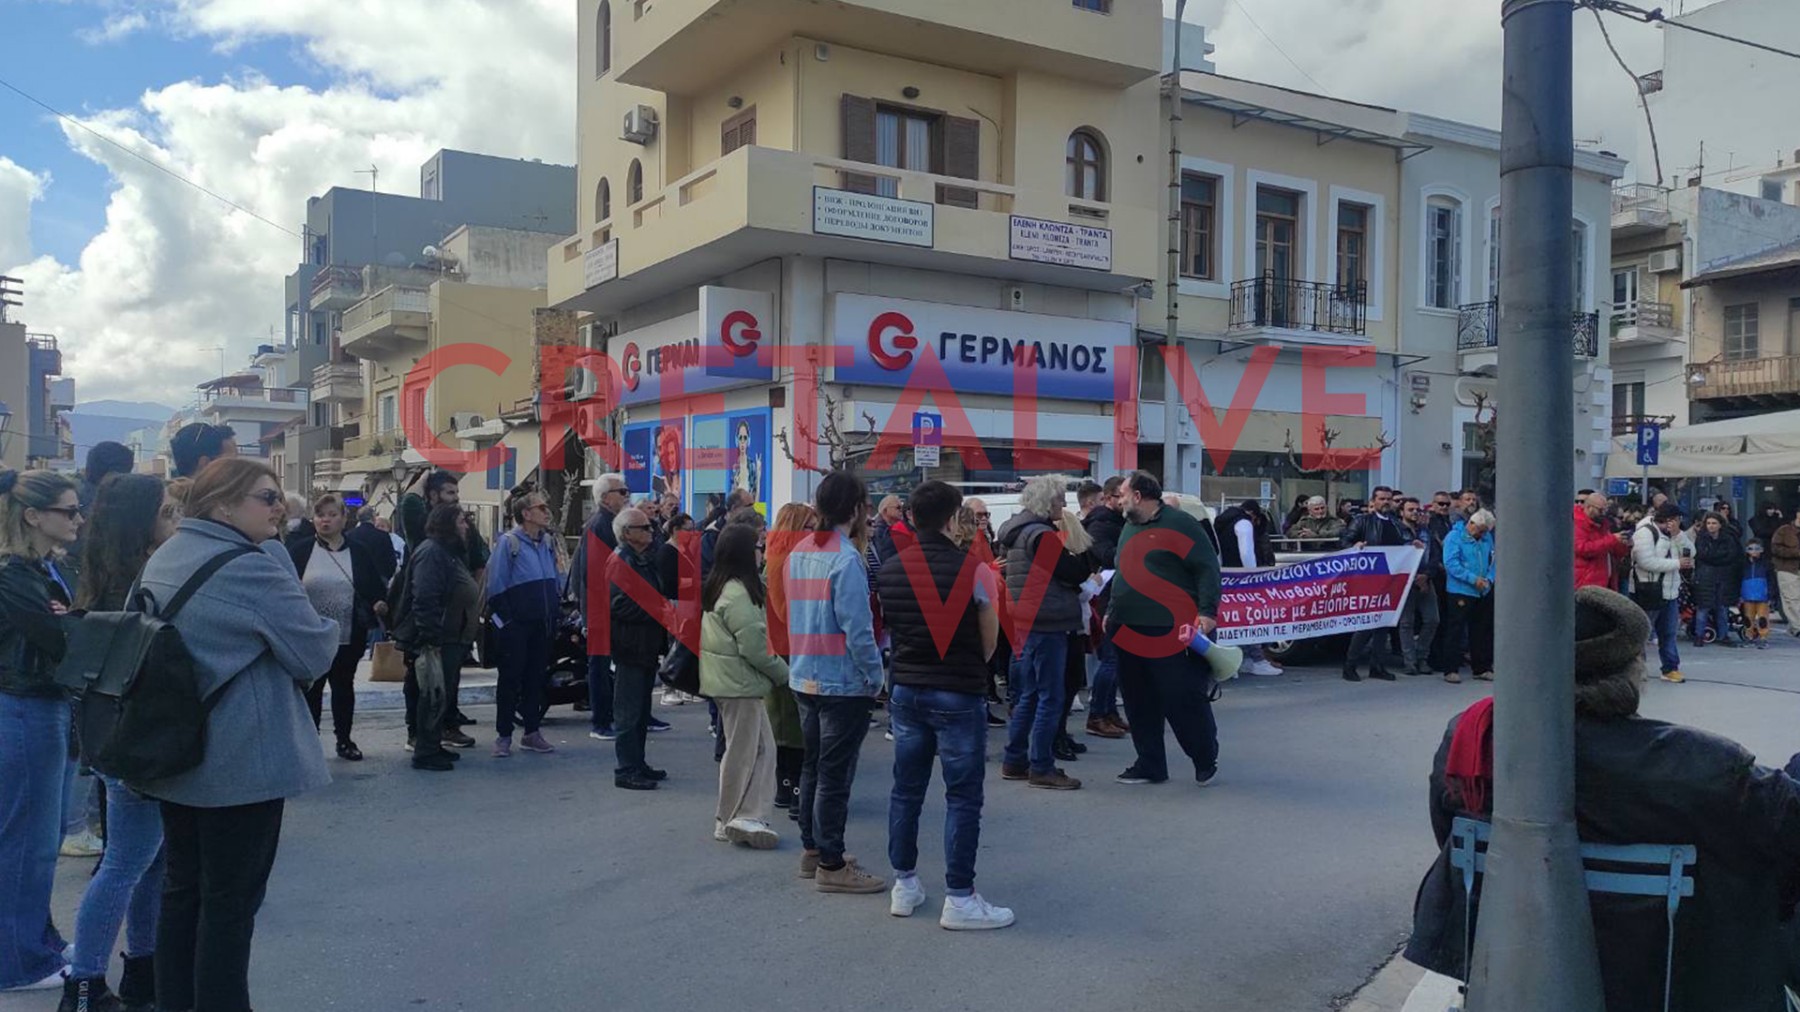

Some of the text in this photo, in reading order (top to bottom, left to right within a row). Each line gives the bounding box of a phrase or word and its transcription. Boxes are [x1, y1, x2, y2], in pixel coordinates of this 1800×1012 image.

[1013, 218, 1037, 229] ΕΛΕΝΗ
[1040, 222, 1074, 235] ΚΛΩΝΤΖΑ
[1080, 228, 1108, 240] ΤΡΑΝΤΑ
[939, 331, 1107, 374] ΓΕΡΜΑΝΟΣ
[1642, 427, 1655, 446] P
[1314, 556, 1378, 576] ΣΧΟΛΕΙΟΥ
[1265, 582, 1328, 601] Μισθούς
[1330, 582, 1348, 598] μας
[1222, 593, 1391, 624] να ζούμε με ΑΞΙΟΠΡΕΠΕΙΑ
